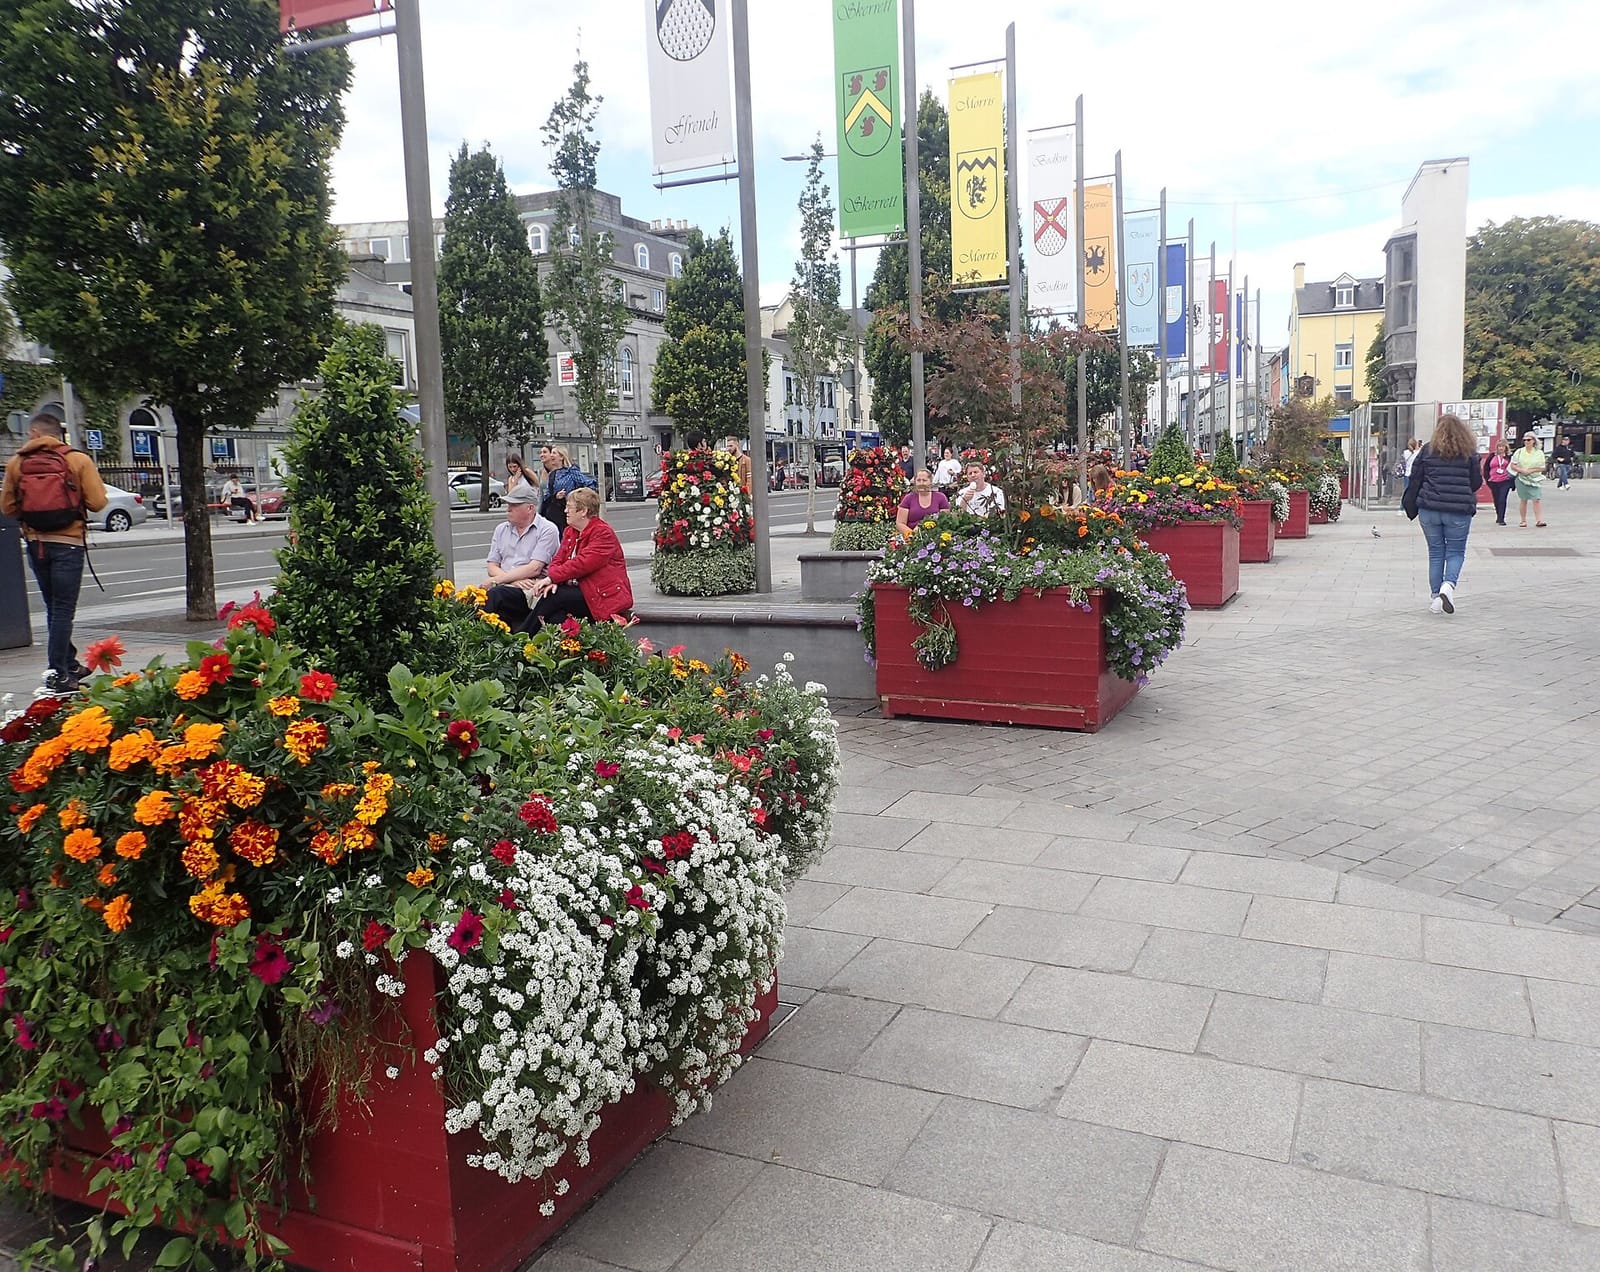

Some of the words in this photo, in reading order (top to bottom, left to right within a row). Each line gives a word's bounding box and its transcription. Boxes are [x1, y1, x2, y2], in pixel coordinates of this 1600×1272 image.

[955, 96, 996, 111] Morris
[664, 110, 719, 145] Ffrench
[842, 194, 898, 214] Skerrett
[958, 250, 999, 265] Morris
